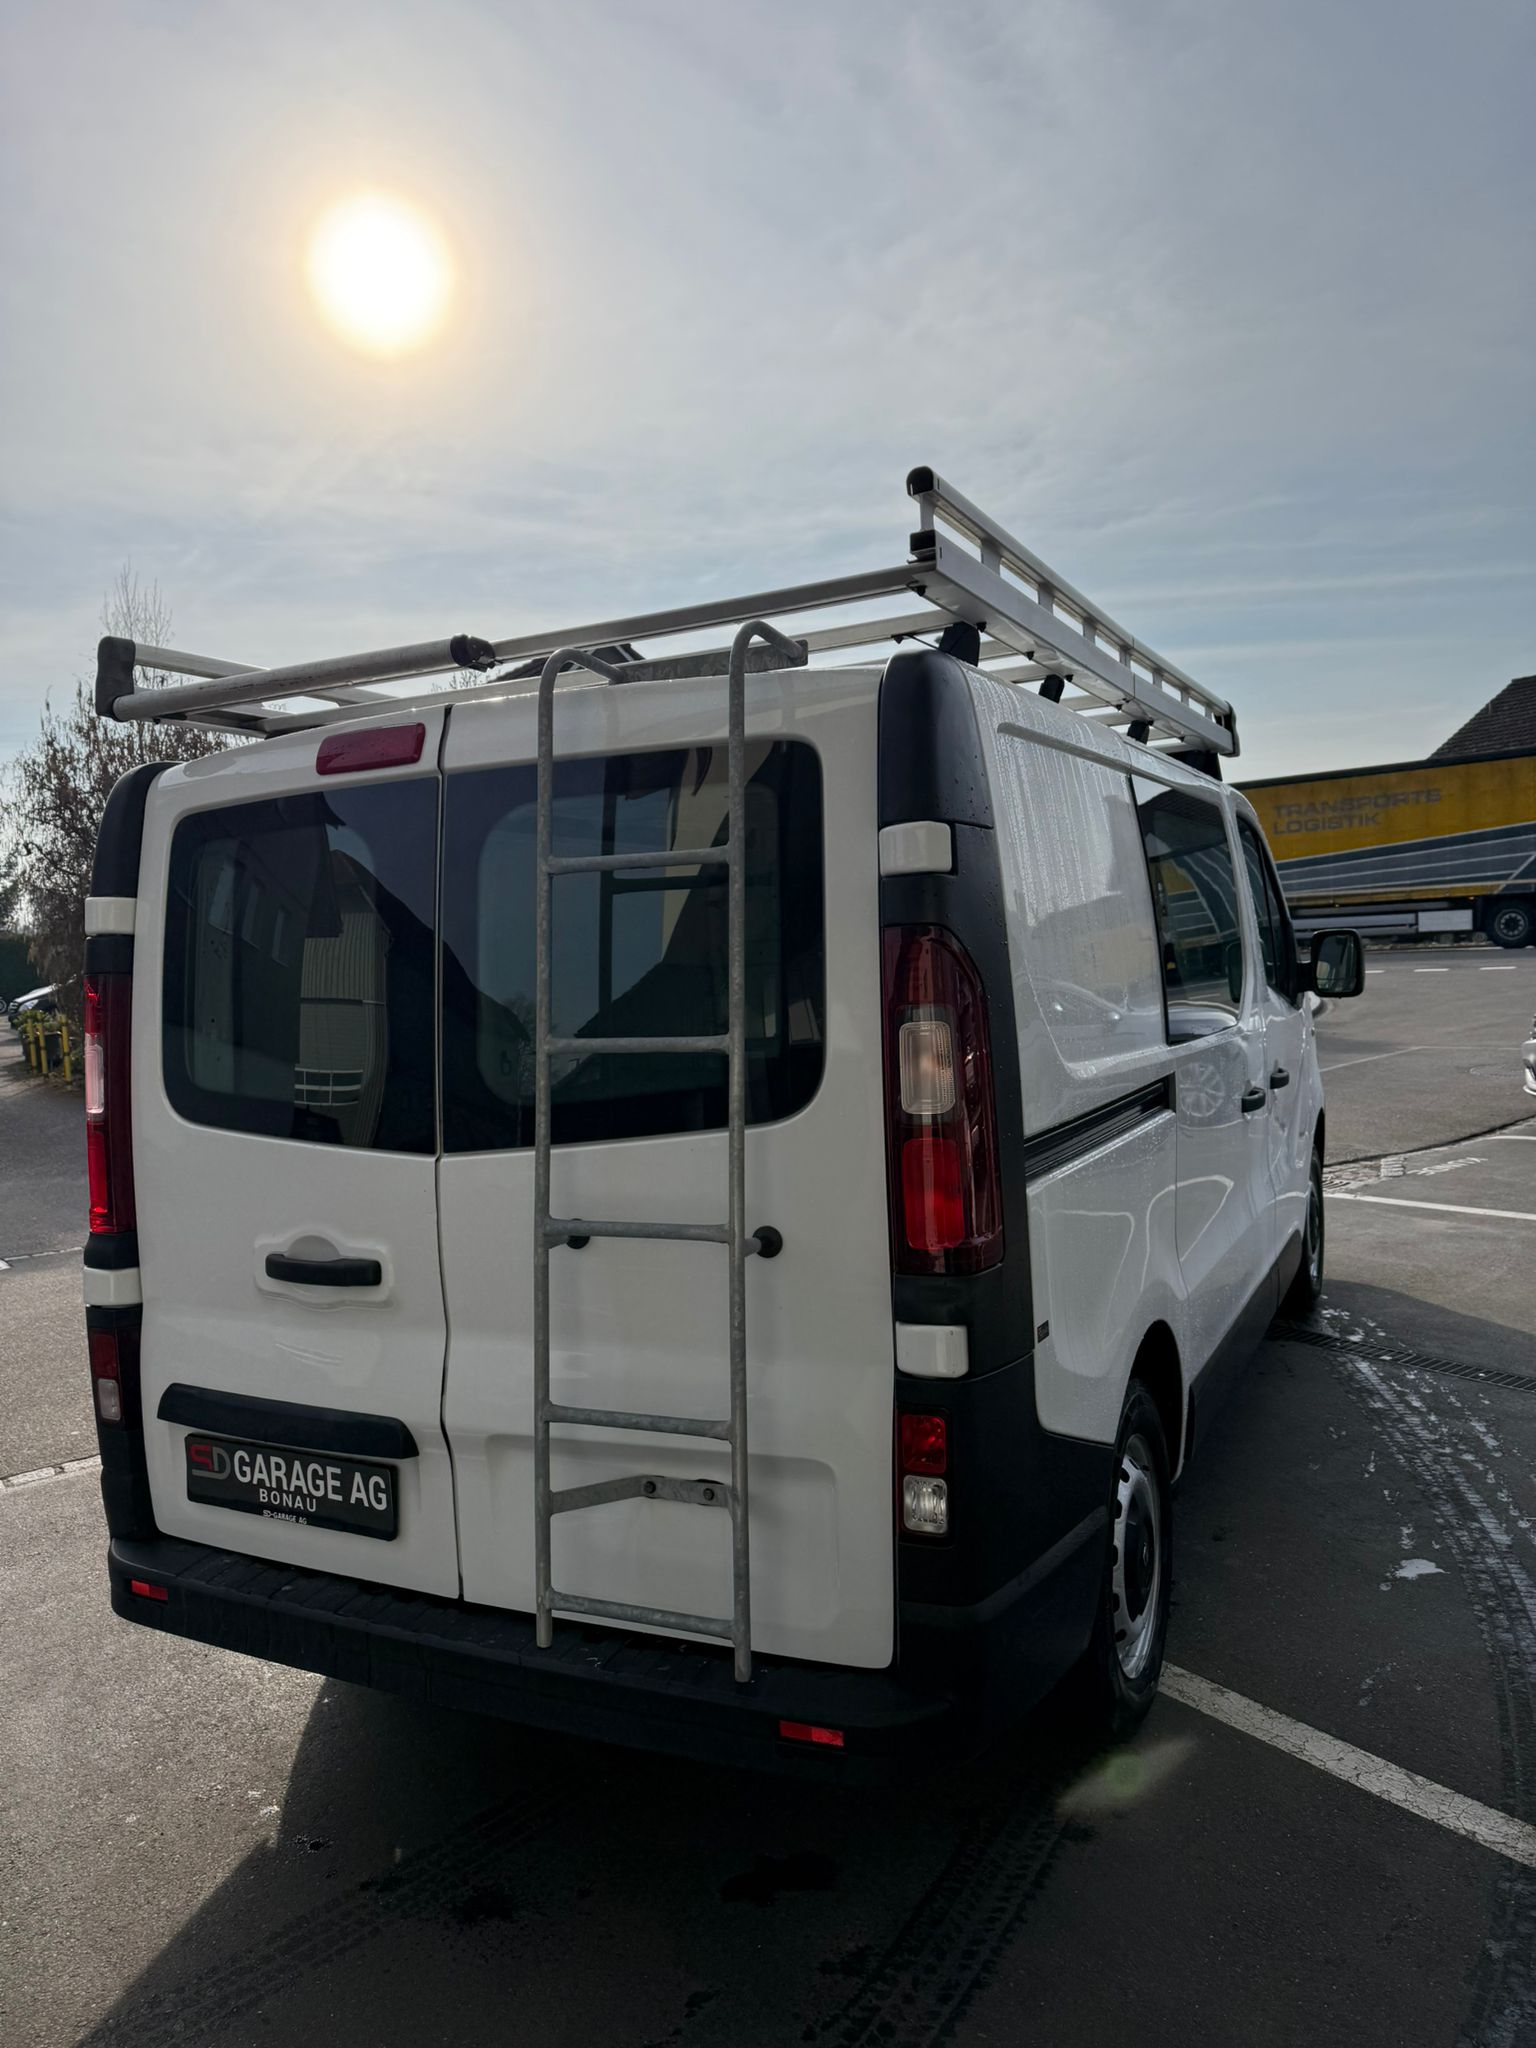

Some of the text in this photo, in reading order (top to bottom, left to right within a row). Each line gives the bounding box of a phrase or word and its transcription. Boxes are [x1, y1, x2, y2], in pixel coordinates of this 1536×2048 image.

[1273, 813, 1380, 834] LOGISTIK
[233, 1450, 343, 1502] GARAGE
[350, 1472, 387, 1511] AG
[259, 1488, 316, 1512] BONAU
[298, 1516, 308, 1525] AG
